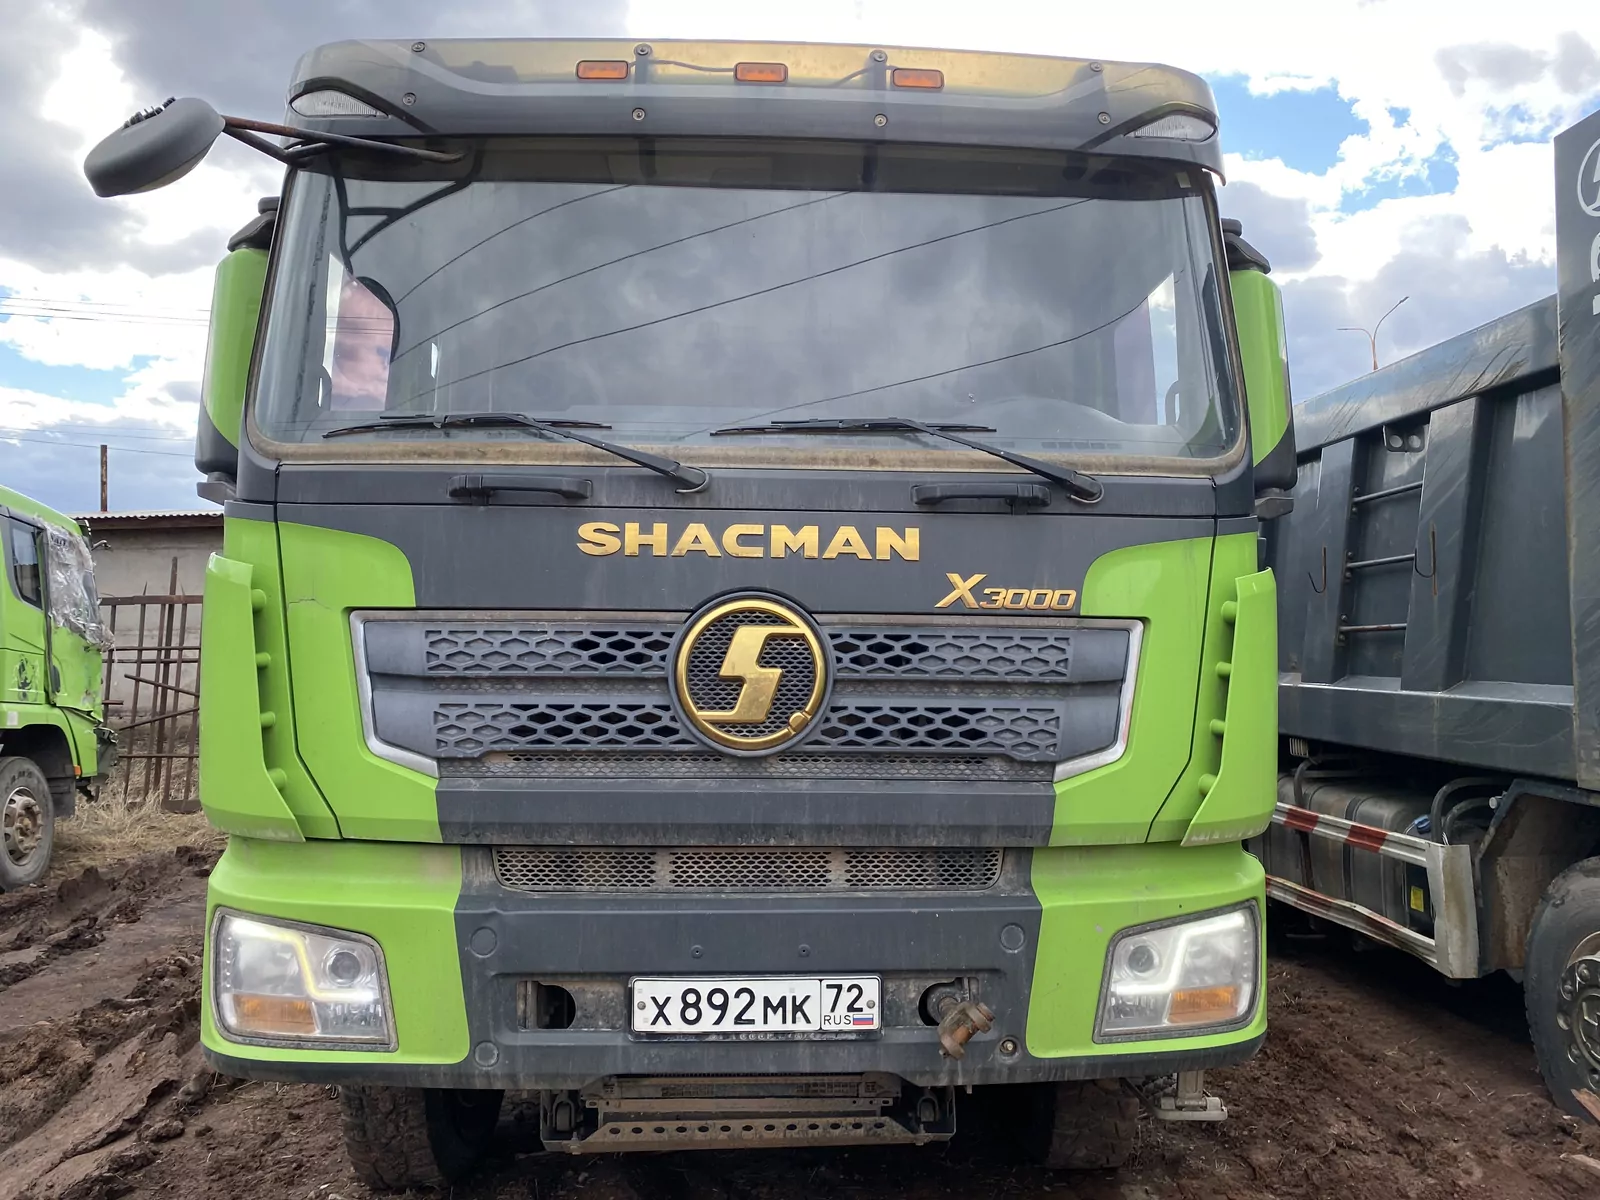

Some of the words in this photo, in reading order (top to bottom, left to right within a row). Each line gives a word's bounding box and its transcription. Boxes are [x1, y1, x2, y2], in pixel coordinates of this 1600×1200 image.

[577, 522, 921, 561] SHACMAN
[935, 572, 1077, 610] X3000
[825, 983, 864, 1013] 72
[823, 1014, 852, 1026] RUS
